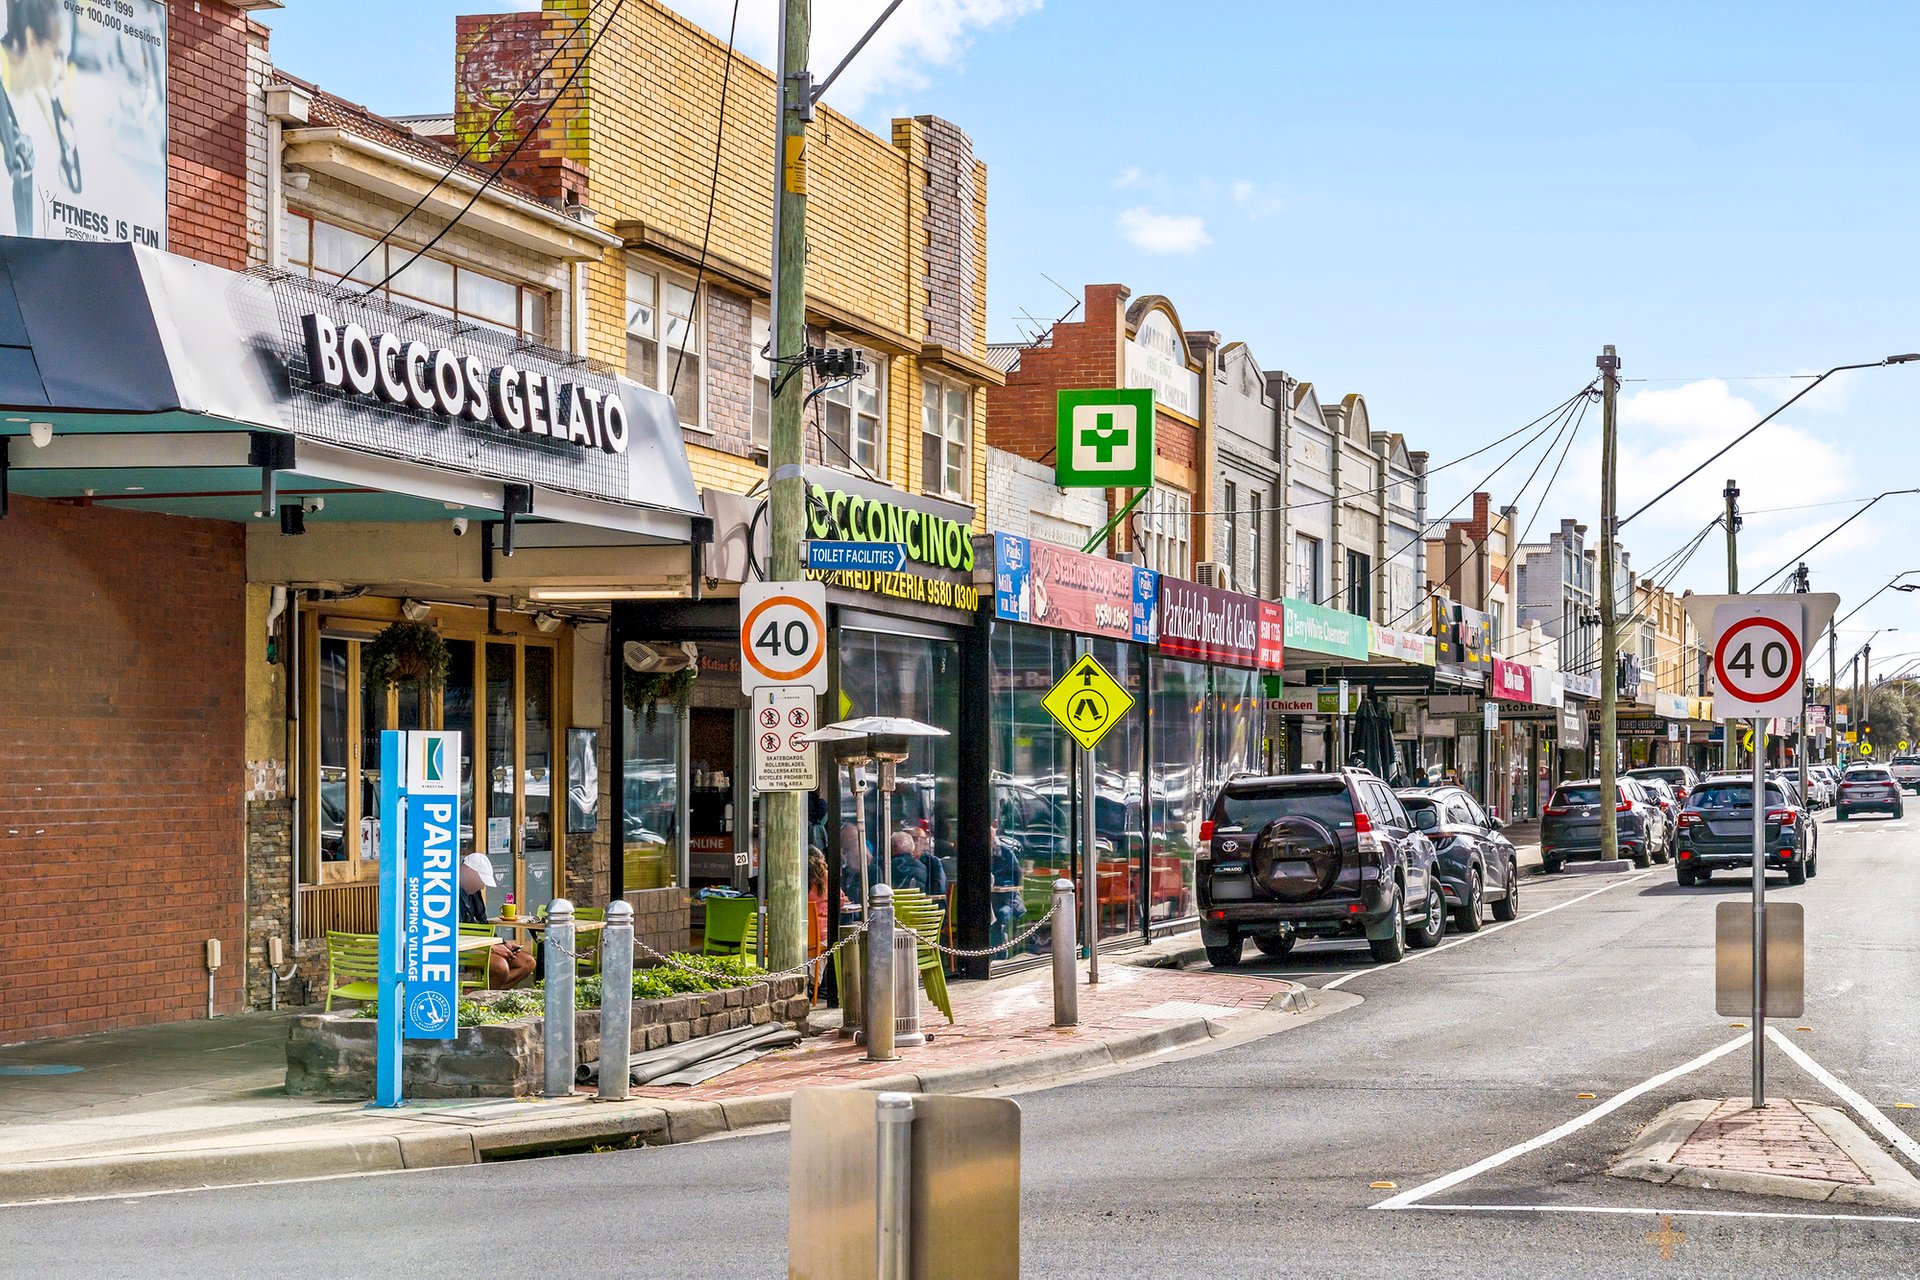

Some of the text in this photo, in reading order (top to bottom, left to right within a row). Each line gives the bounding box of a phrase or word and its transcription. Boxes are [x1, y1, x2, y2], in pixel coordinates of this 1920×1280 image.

[63, 1, 161, 47] over 100,000 sessions
[113, 1, 134, 18] 1999
[53, 200, 159, 249] FITNESS IS FUN
[302, 313, 629, 454] BOCCOS GELATO
[812, 548, 895, 565] TOILET FACILITIES
[1054, 552, 1129, 597] Station Stop Cafe
[873, 571, 926, 602] PIZZERIA
[927, 579, 952, 608] 9580
[954, 584, 979, 612] 0300
[998, 574, 1013, 593] Milk
[755, 620, 809, 656] 40
[1163, 587, 1256, 650] Parkdale Bread & Cakes
[1727, 641, 1788, 679] 40
[1272, 700, 1313, 710] Chicken
[736, 854, 748, 864] 20
[421, 803, 452, 983] PARKDALE
[408, 876, 419, 982] SHOPPING VILLAGE
